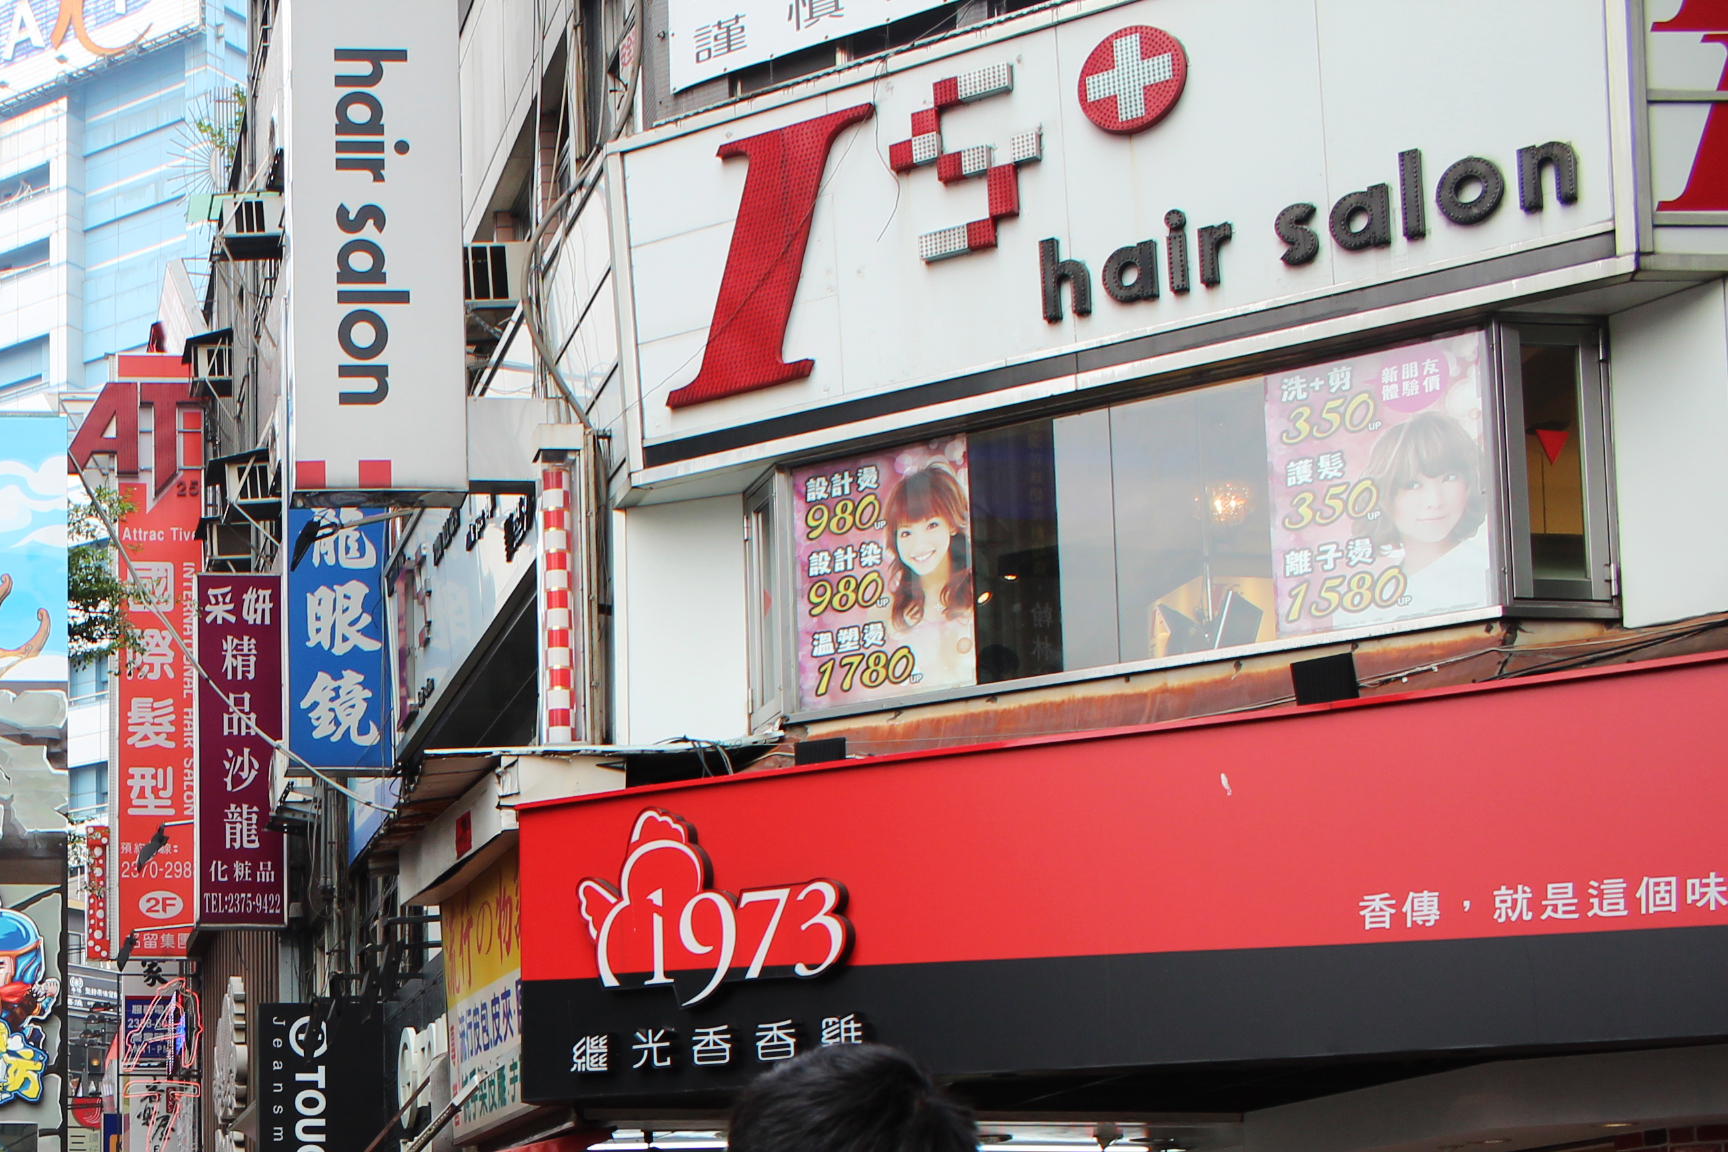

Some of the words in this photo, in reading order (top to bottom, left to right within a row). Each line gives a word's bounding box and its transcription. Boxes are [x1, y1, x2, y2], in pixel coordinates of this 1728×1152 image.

[333, 48, 410, 183] hair
[1038, 209, 1233, 323] hair
[1274, 140, 1578, 266] salon
[335, 202, 410, 406] salon
[1280, 393, 1375, 444] 350
[1368, 421, 1382, 431] UP
[805, 466, 880, 502] 設計燙
[1285, 452, 1345, 487] 護髮
[806, 493, 881, 540] 980
[874, 520, 887, 530] UP
[1283, 479, 1379, 530] 350
[1367, 511, 1381, 520] UP
[122, 527, 165, 542] Attrac
[1285, 537, 1373, 577] 離子燙
[809, 542, 882, 577] 設計染
[809, 571, 884, 616] 980
[876, 598, 889, 608] UP
[1287, 567, 1407, 623] 1580
[1397, 596, 1411, 606] UP
[125, 561, 175, 817] 國際髮型
[815, 646, 915, 697] 1780
[909, 674, 922, 684] UP
[182, 708, 194, 749] HAIR
[221, 635, 260, 849] 精品沙龍
[182, 757, 194, 817] SALON
[209, 860, 275, 883] 化粧品
[145, 897, 177, 914] 2F
